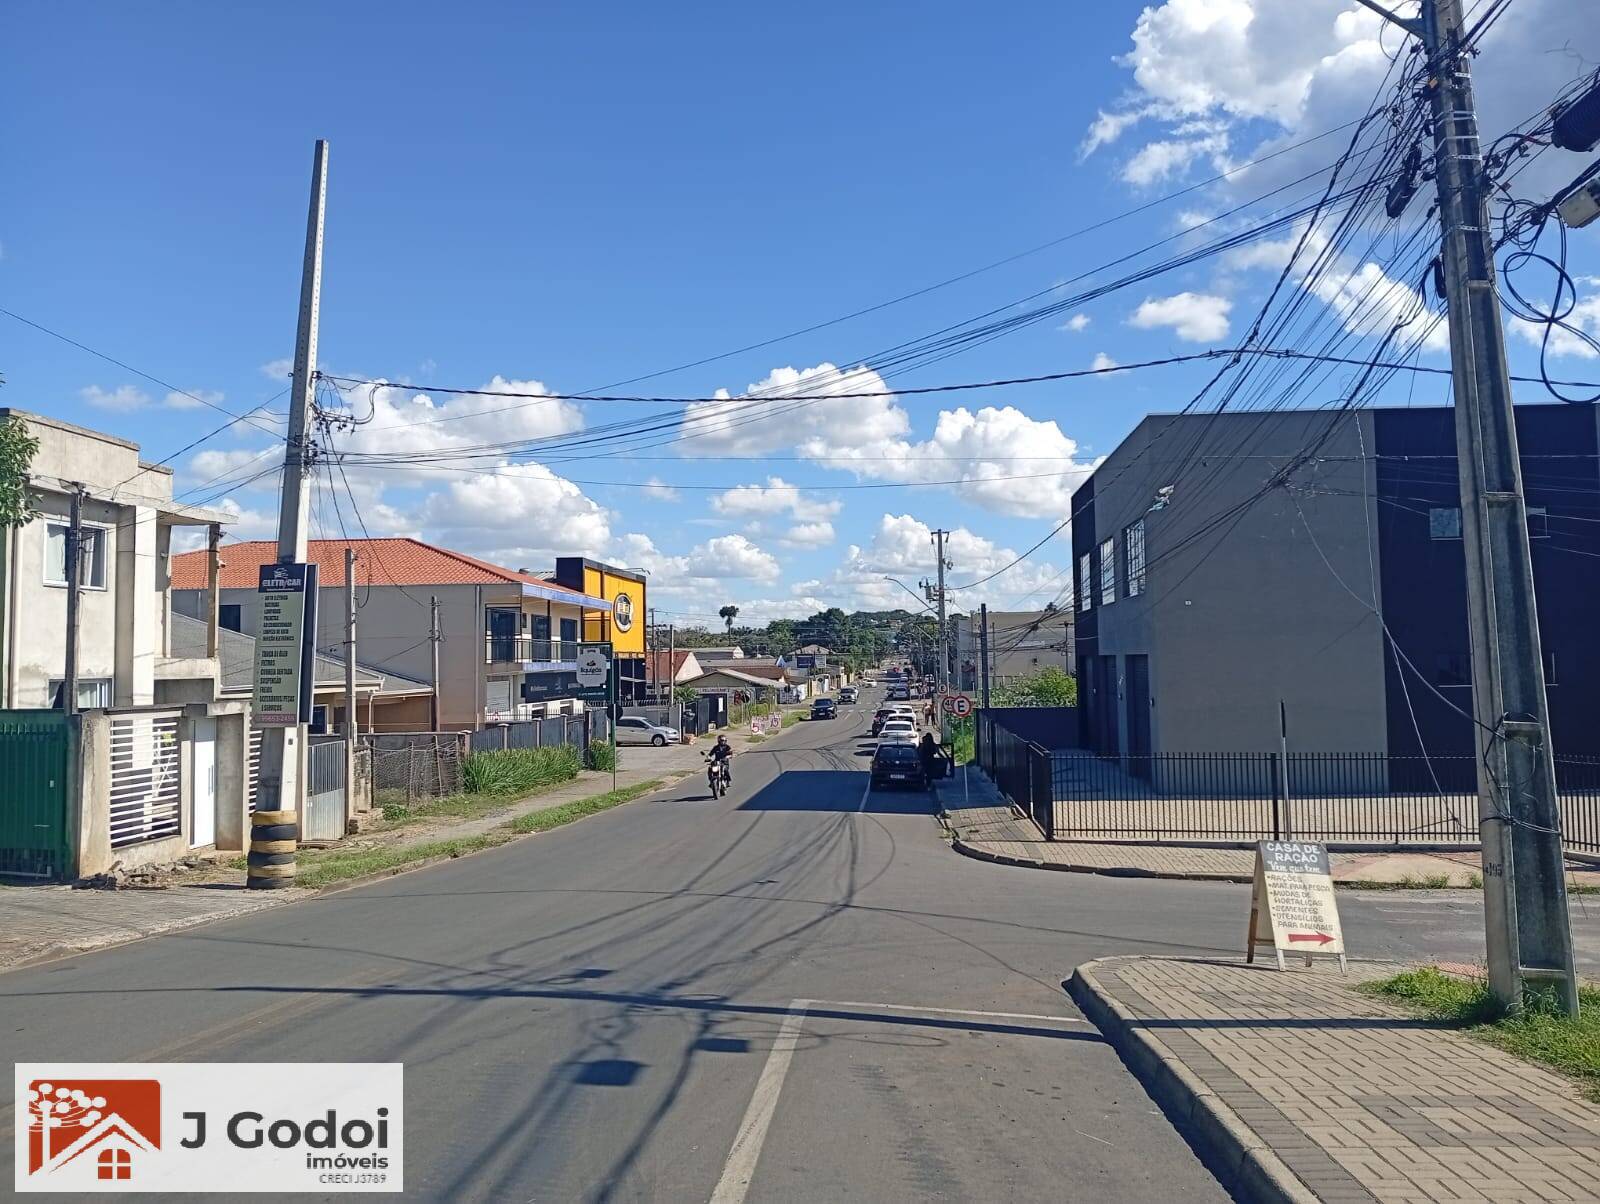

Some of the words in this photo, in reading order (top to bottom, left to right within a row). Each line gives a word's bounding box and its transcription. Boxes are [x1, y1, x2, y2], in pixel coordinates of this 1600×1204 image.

[957, 700, 966, 712] E
[1266, 842, 1301, 853] CASA
[1303, 844, 1320, 854] DE
[1274, 852, 1318, 864] RAÇÃO
